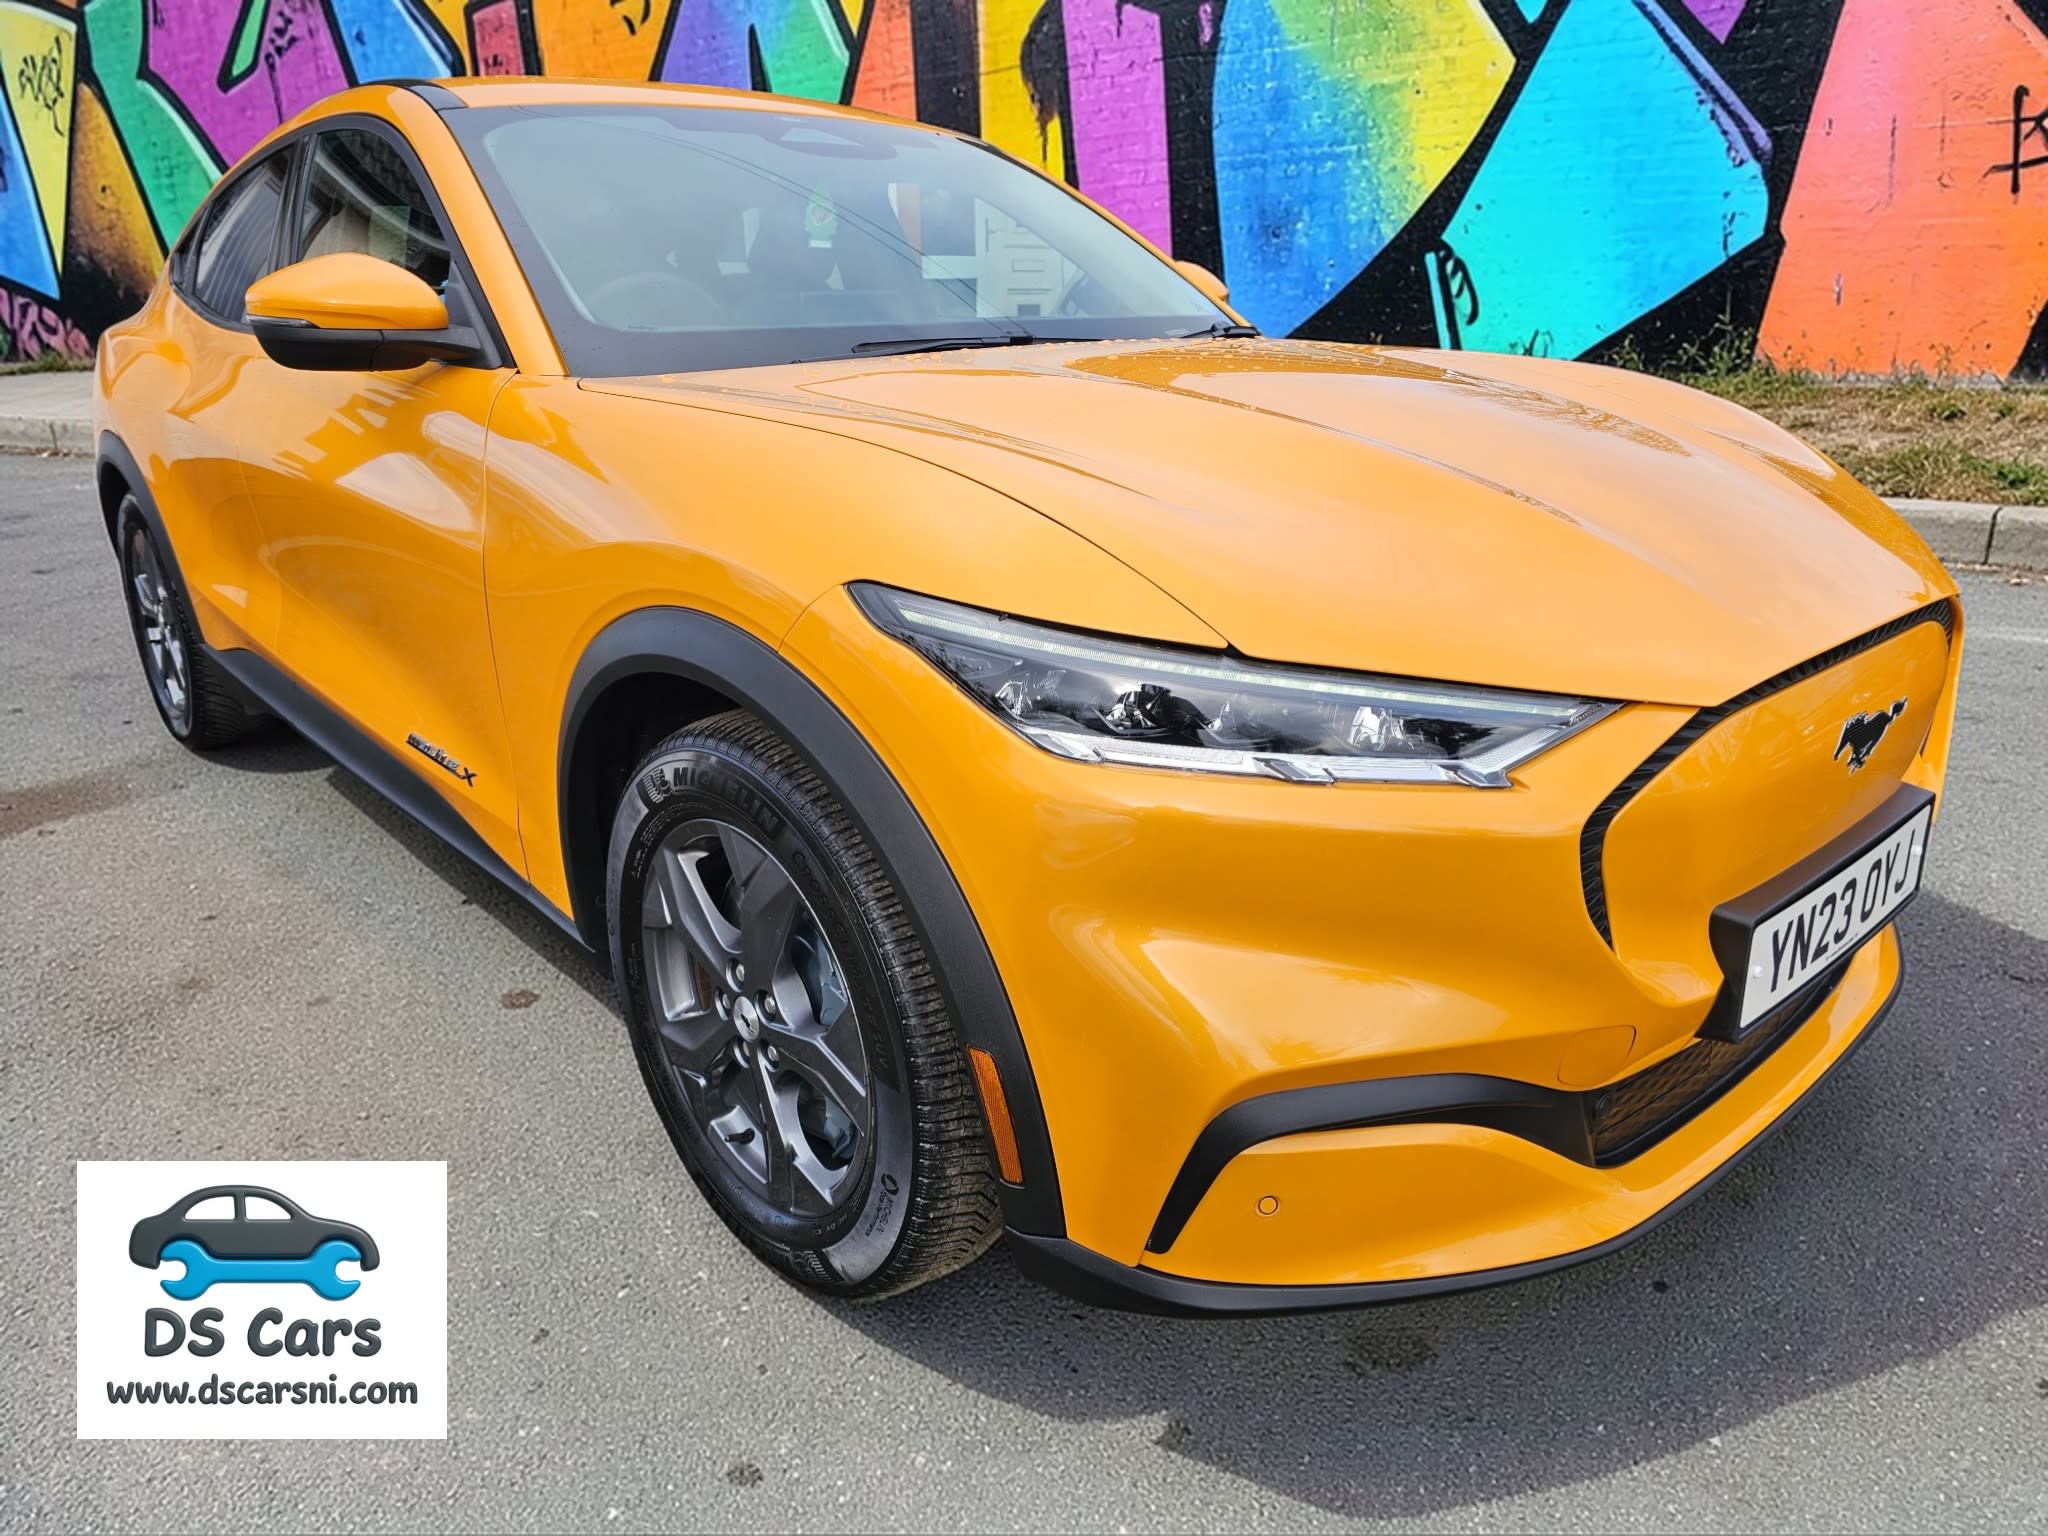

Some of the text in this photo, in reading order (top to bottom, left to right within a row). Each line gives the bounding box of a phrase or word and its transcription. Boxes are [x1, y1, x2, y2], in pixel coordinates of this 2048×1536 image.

[673, 766, 781, 834] MICHELIN
[1770, 828, 1916, 993] YN23 OYJ
